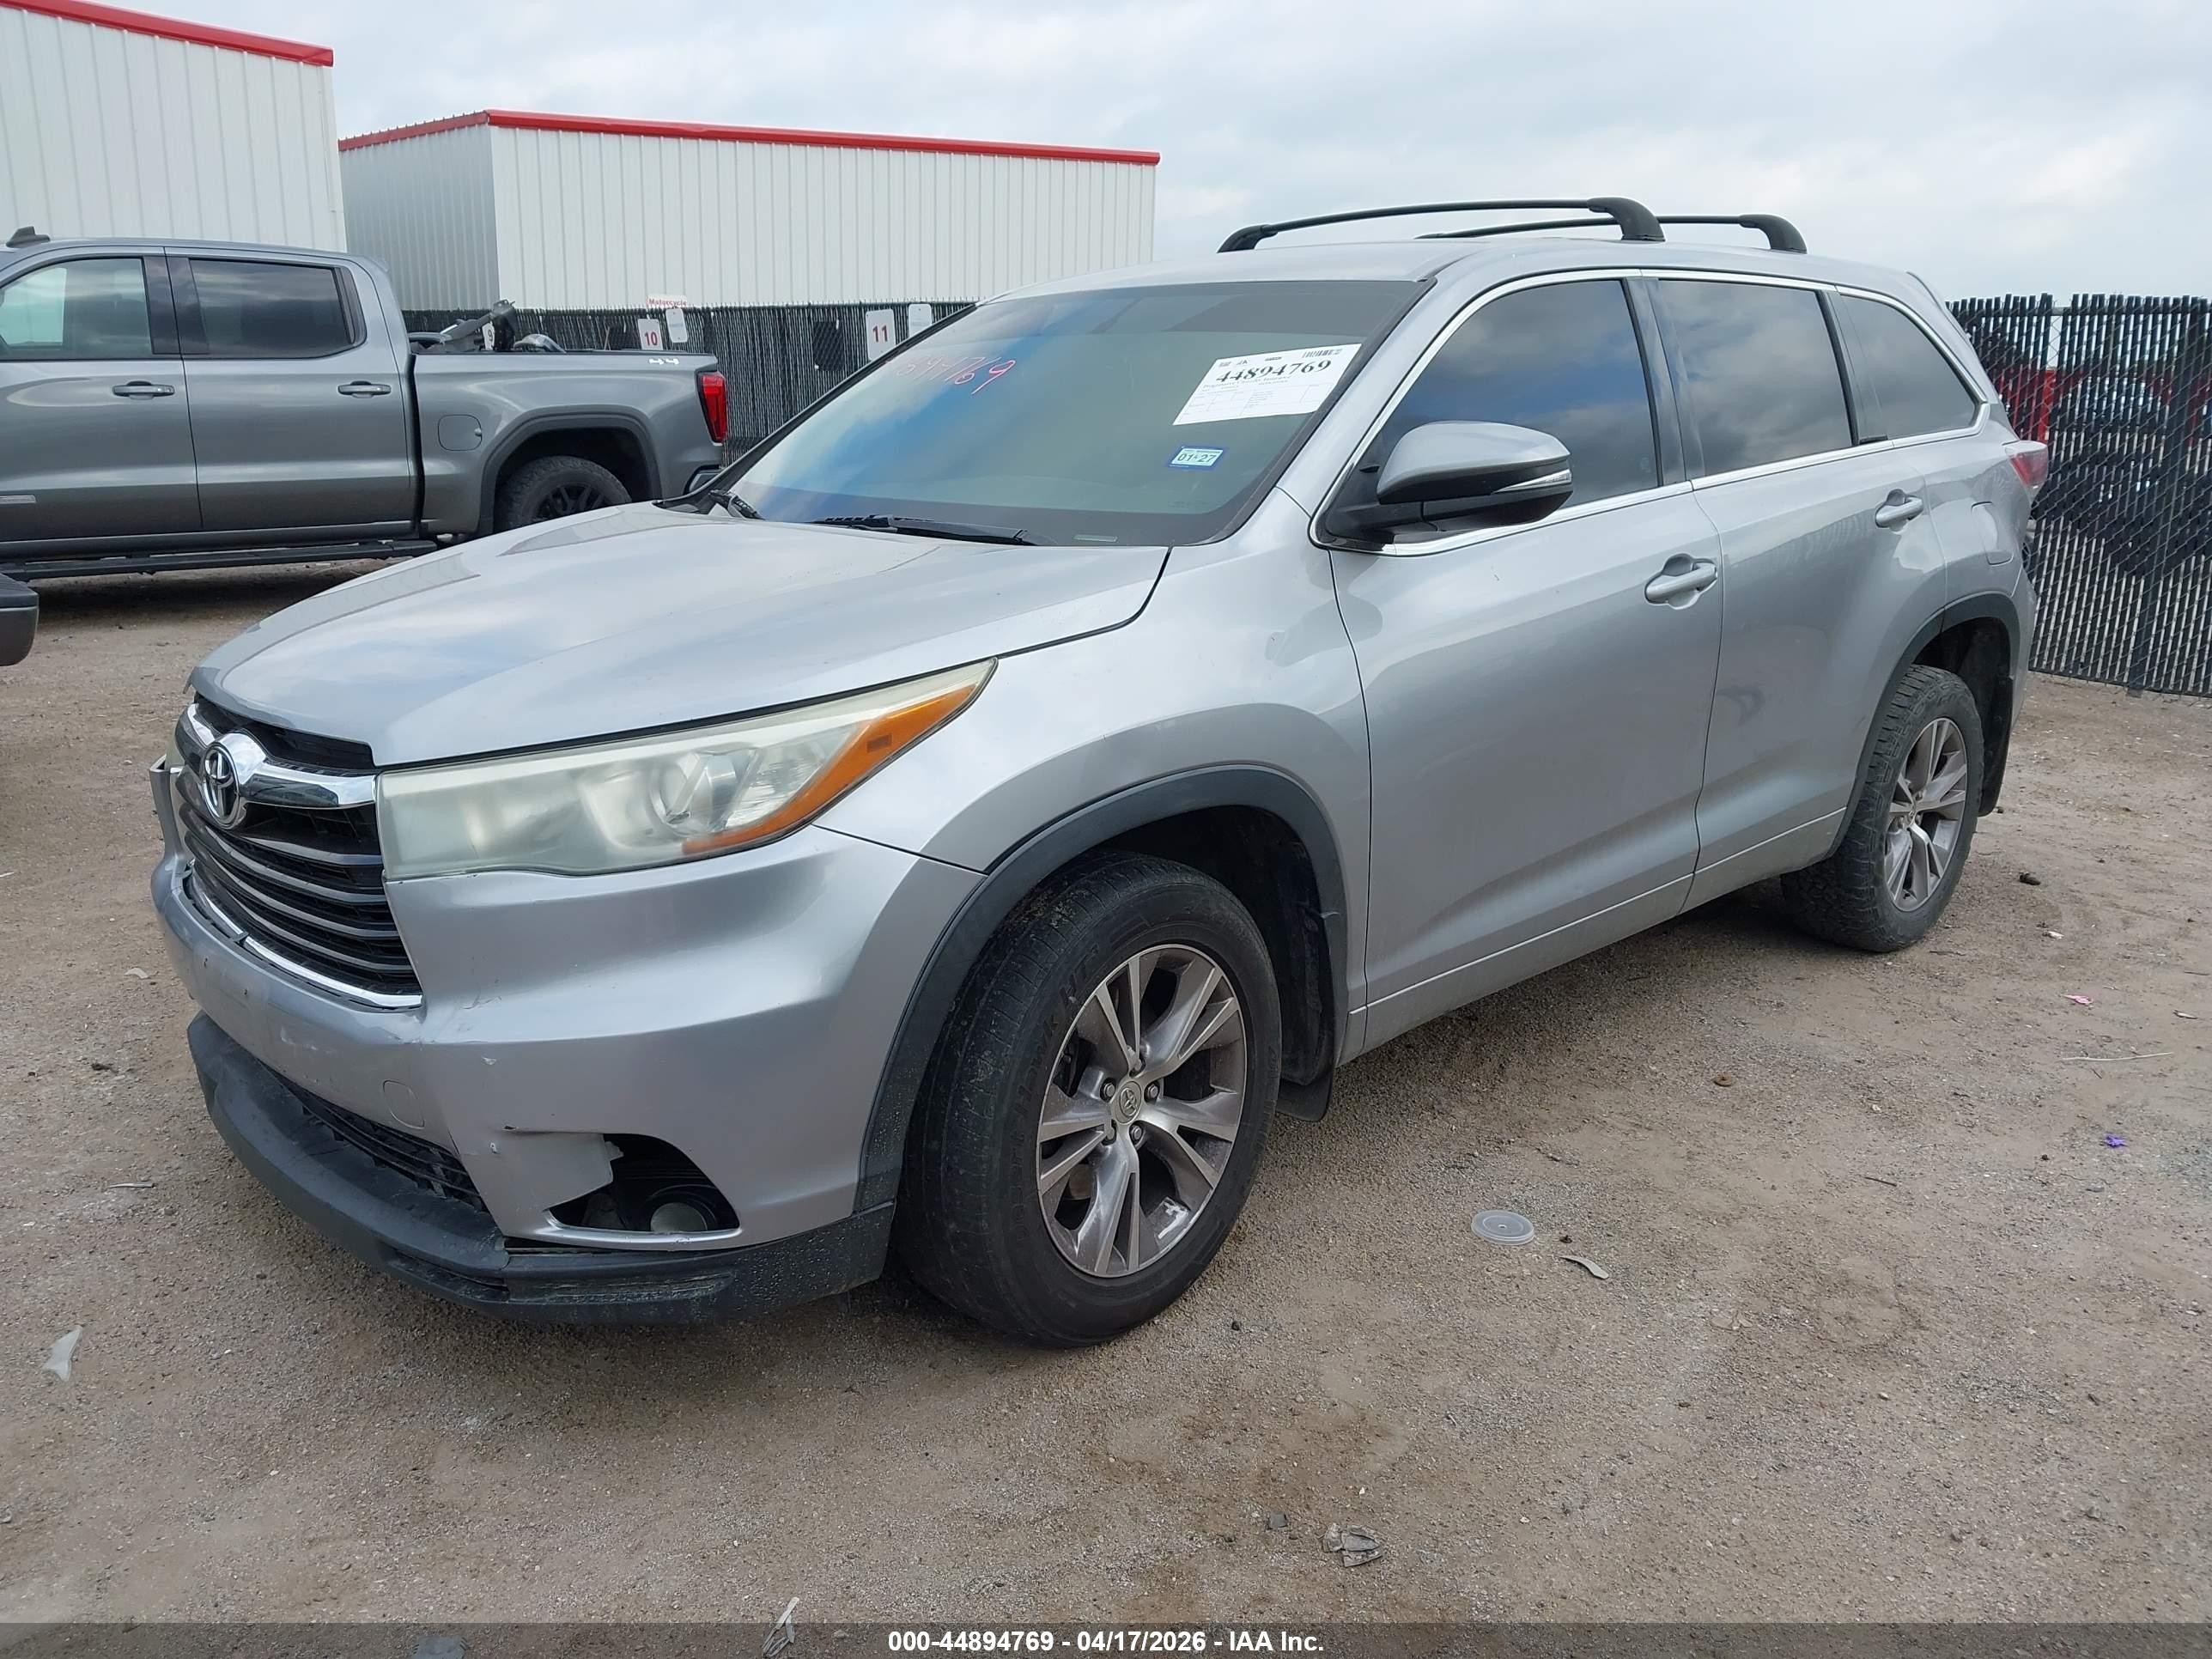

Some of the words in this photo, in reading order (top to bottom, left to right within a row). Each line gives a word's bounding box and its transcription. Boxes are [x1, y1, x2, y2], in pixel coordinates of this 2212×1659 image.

[487, 329, 494, 342] 9
[644, 331, 659, 346] 10
[872, 325, 888, 343] 11
[1216, 359, 1332, 383] 44894769
